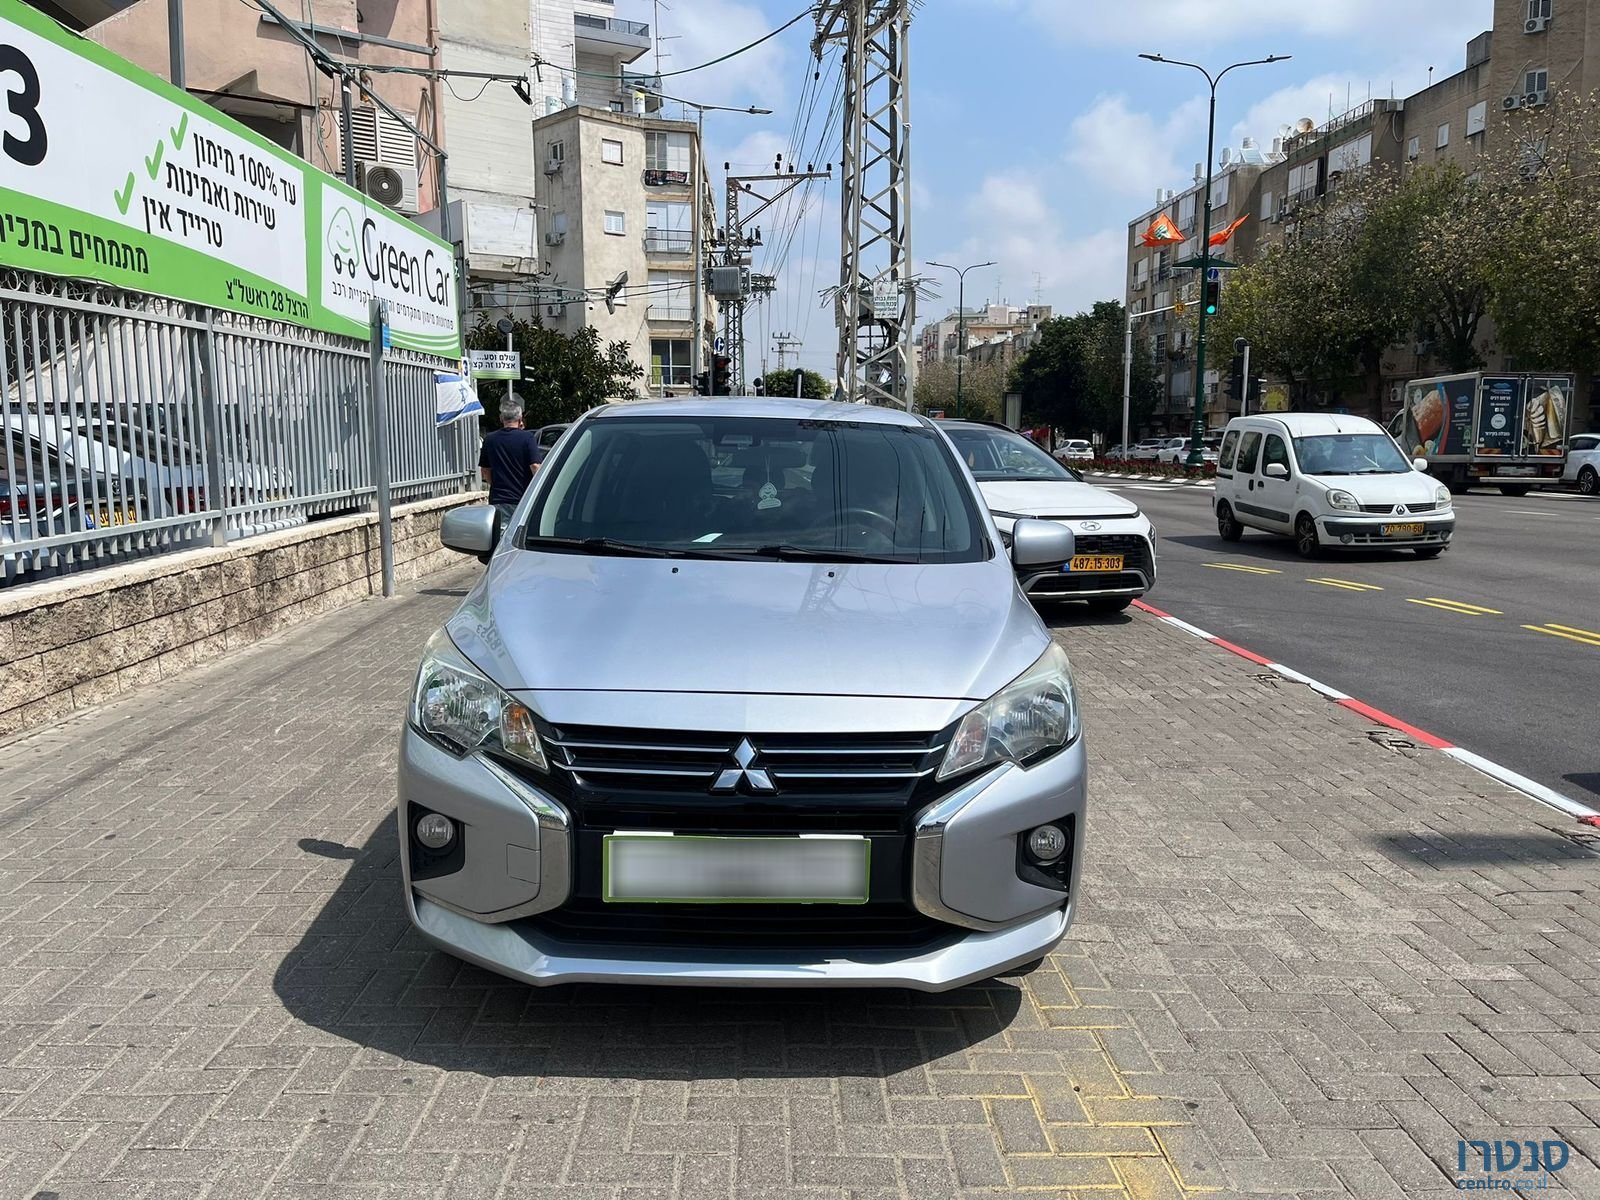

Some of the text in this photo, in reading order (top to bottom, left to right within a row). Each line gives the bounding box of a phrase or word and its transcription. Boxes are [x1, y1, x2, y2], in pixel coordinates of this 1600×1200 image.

[193, 132, 296, 206] עד 100% מימון
[166, 161, 276, 230] שירות ואמינות
[142, 195, 223, 248] טרייד אין
[69, 229, 149, 274] מתמחים
[362, 217, 450, 307] Green Car
[270, 290, 284, 312] 28
[332, 281, 346, 298] רכב
[285, 293, 309, 319] הרצל
[396, 303, 421, 321] מתקדמים
[485, 361, 494, 369] זה
[495, 361, 516, 369] אצלנו
[499, 353, 516, 361] שלם
